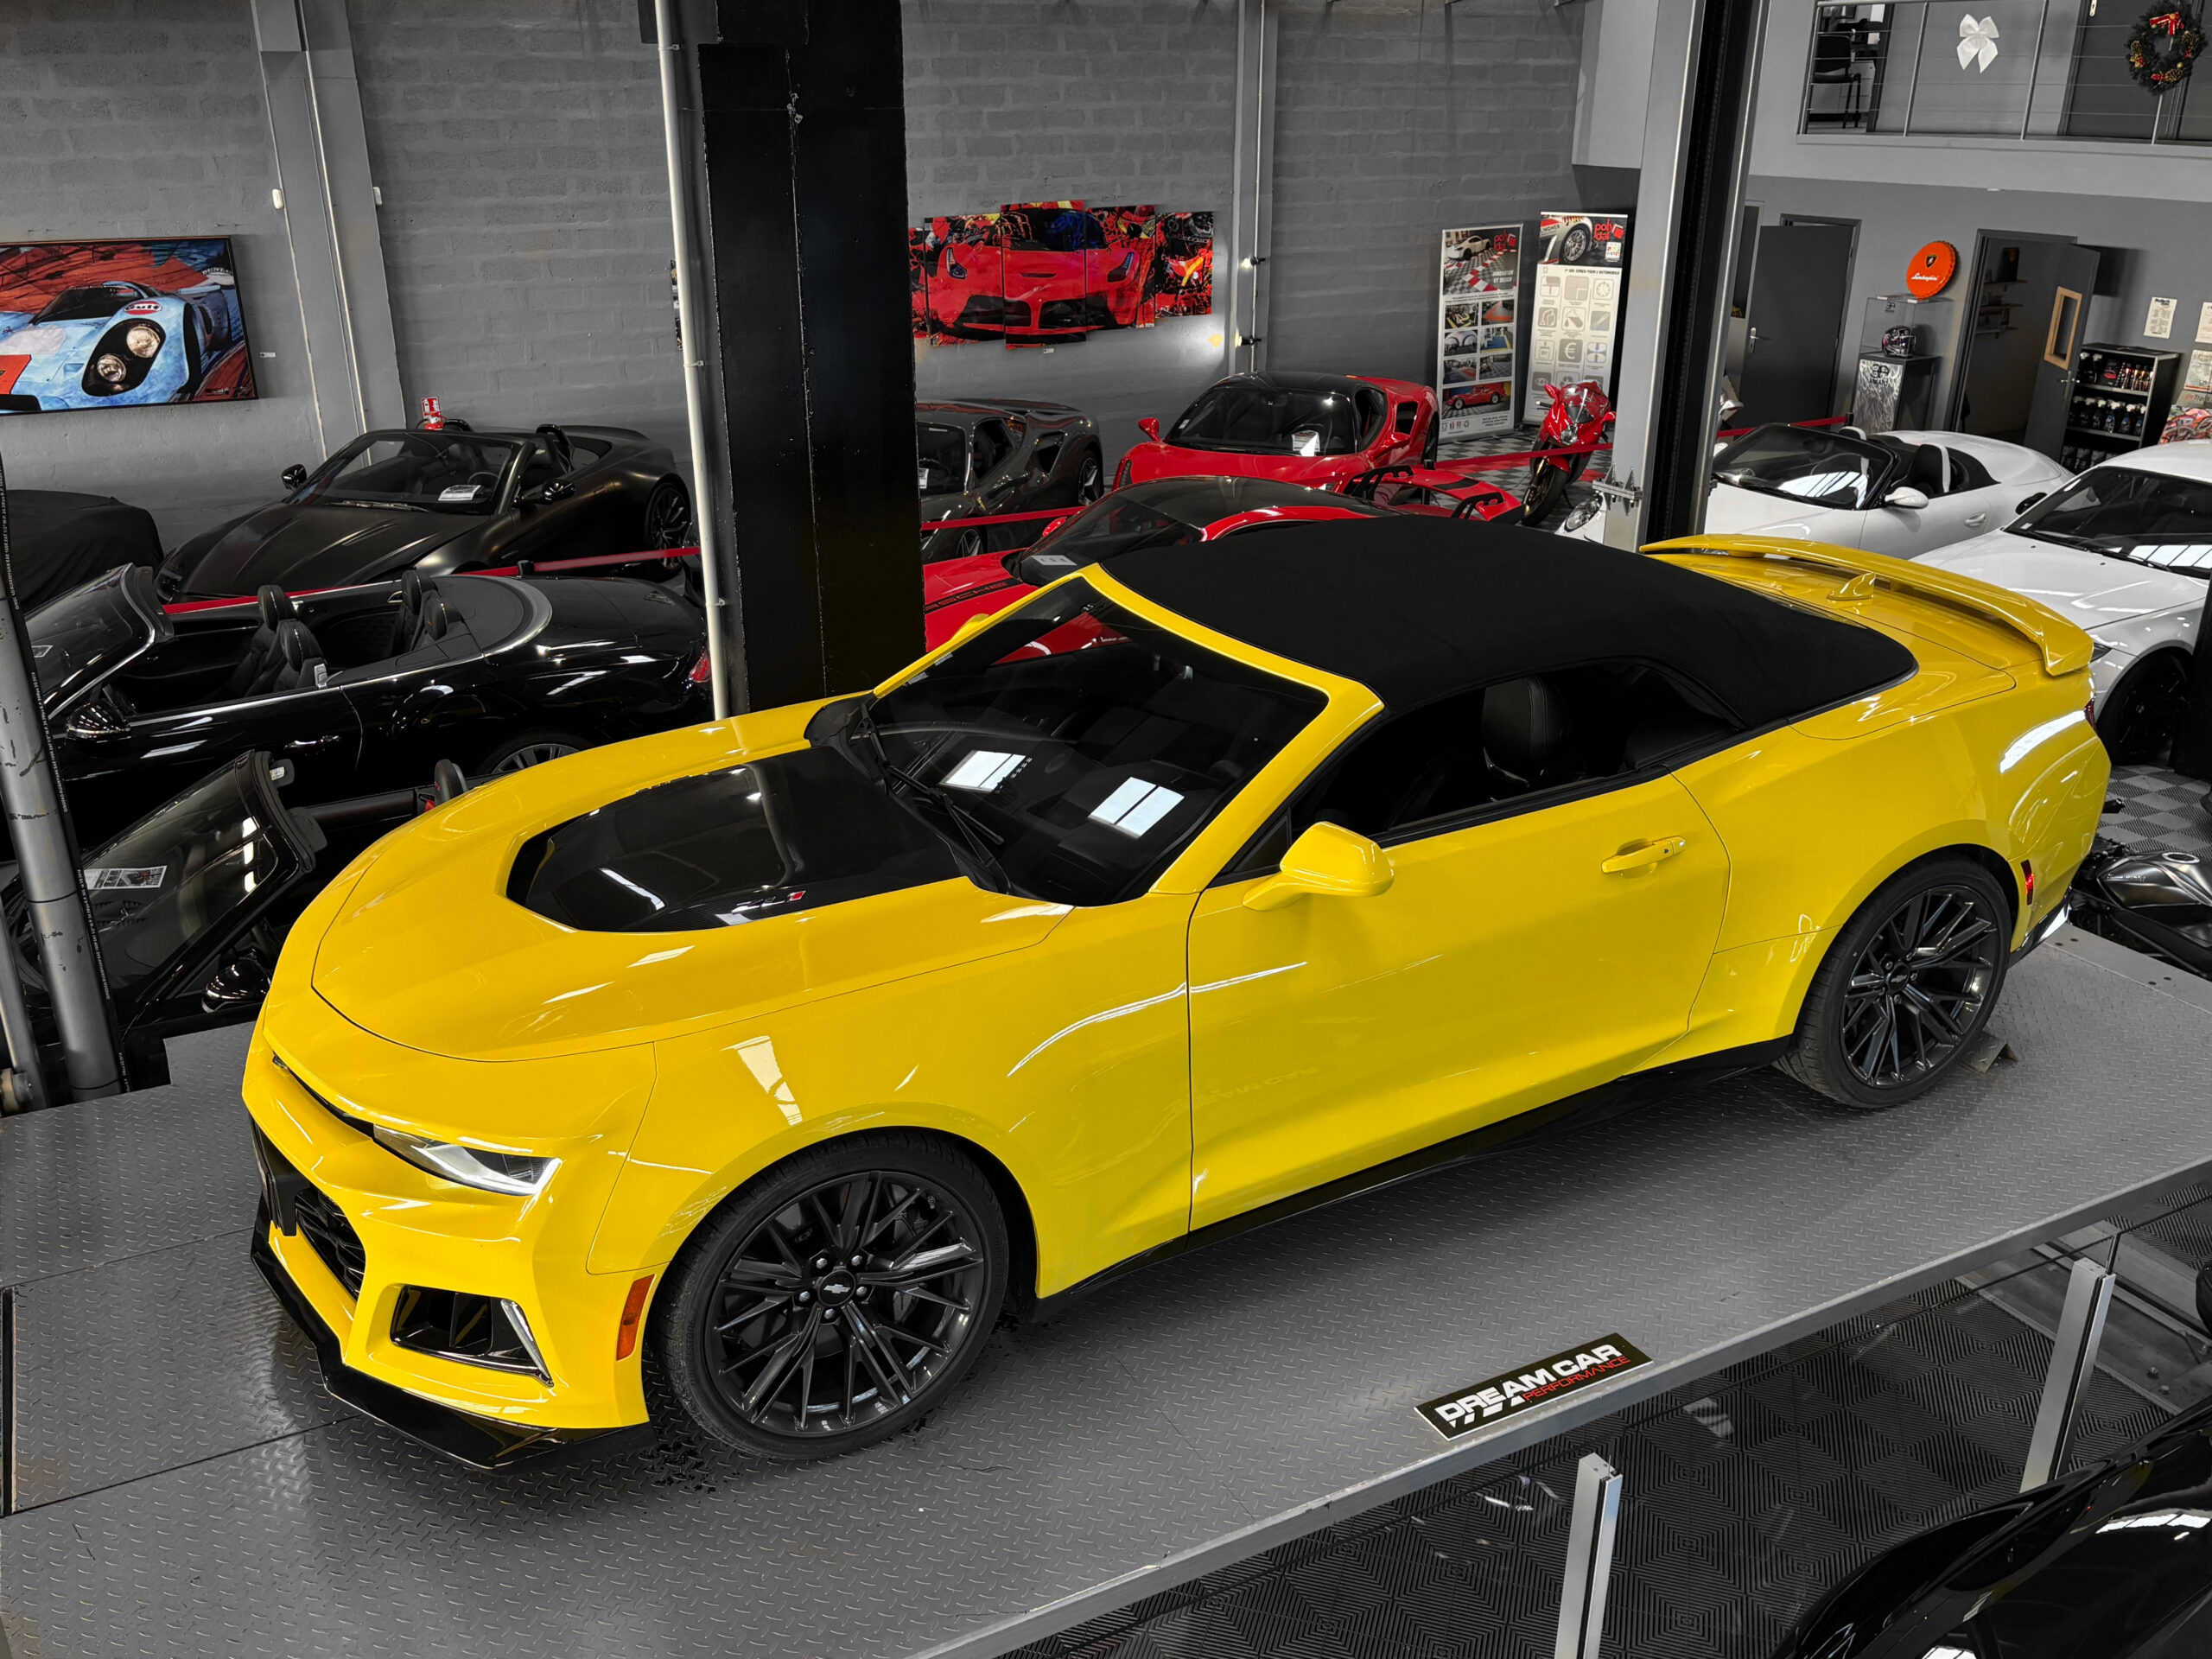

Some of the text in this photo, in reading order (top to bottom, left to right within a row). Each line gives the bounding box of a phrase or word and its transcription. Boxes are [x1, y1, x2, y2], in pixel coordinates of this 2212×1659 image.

[1434, 1344, 1623, 1422] DREAM CAR
[1523, 1355, 1631, 1402] PERFORMANCE
